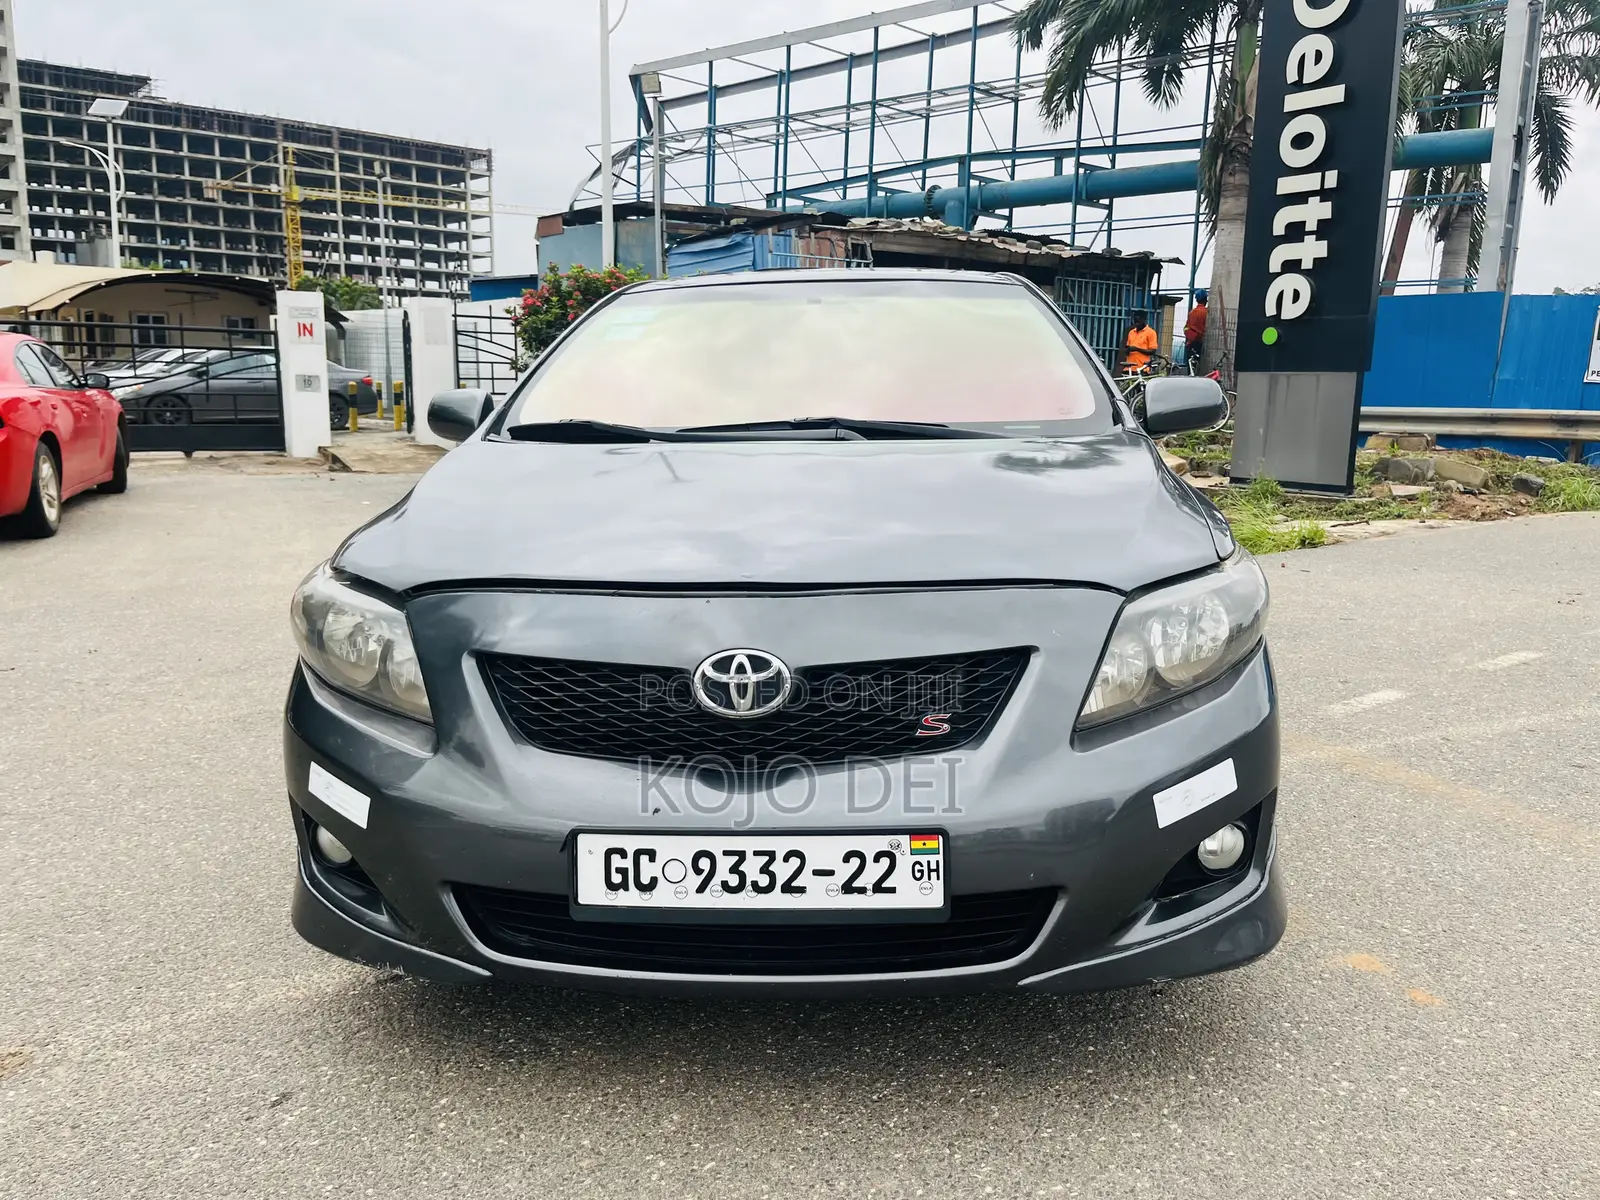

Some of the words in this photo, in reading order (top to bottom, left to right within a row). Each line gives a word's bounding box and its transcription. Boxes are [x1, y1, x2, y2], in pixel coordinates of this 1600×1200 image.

[297, 322, 313, 337] IN
[915, 713, 952, 736] S
[604, 847, 658, 892] GC
[691, 849, 897, 894] 9332-22
[911, 860, 940, 881] GH
